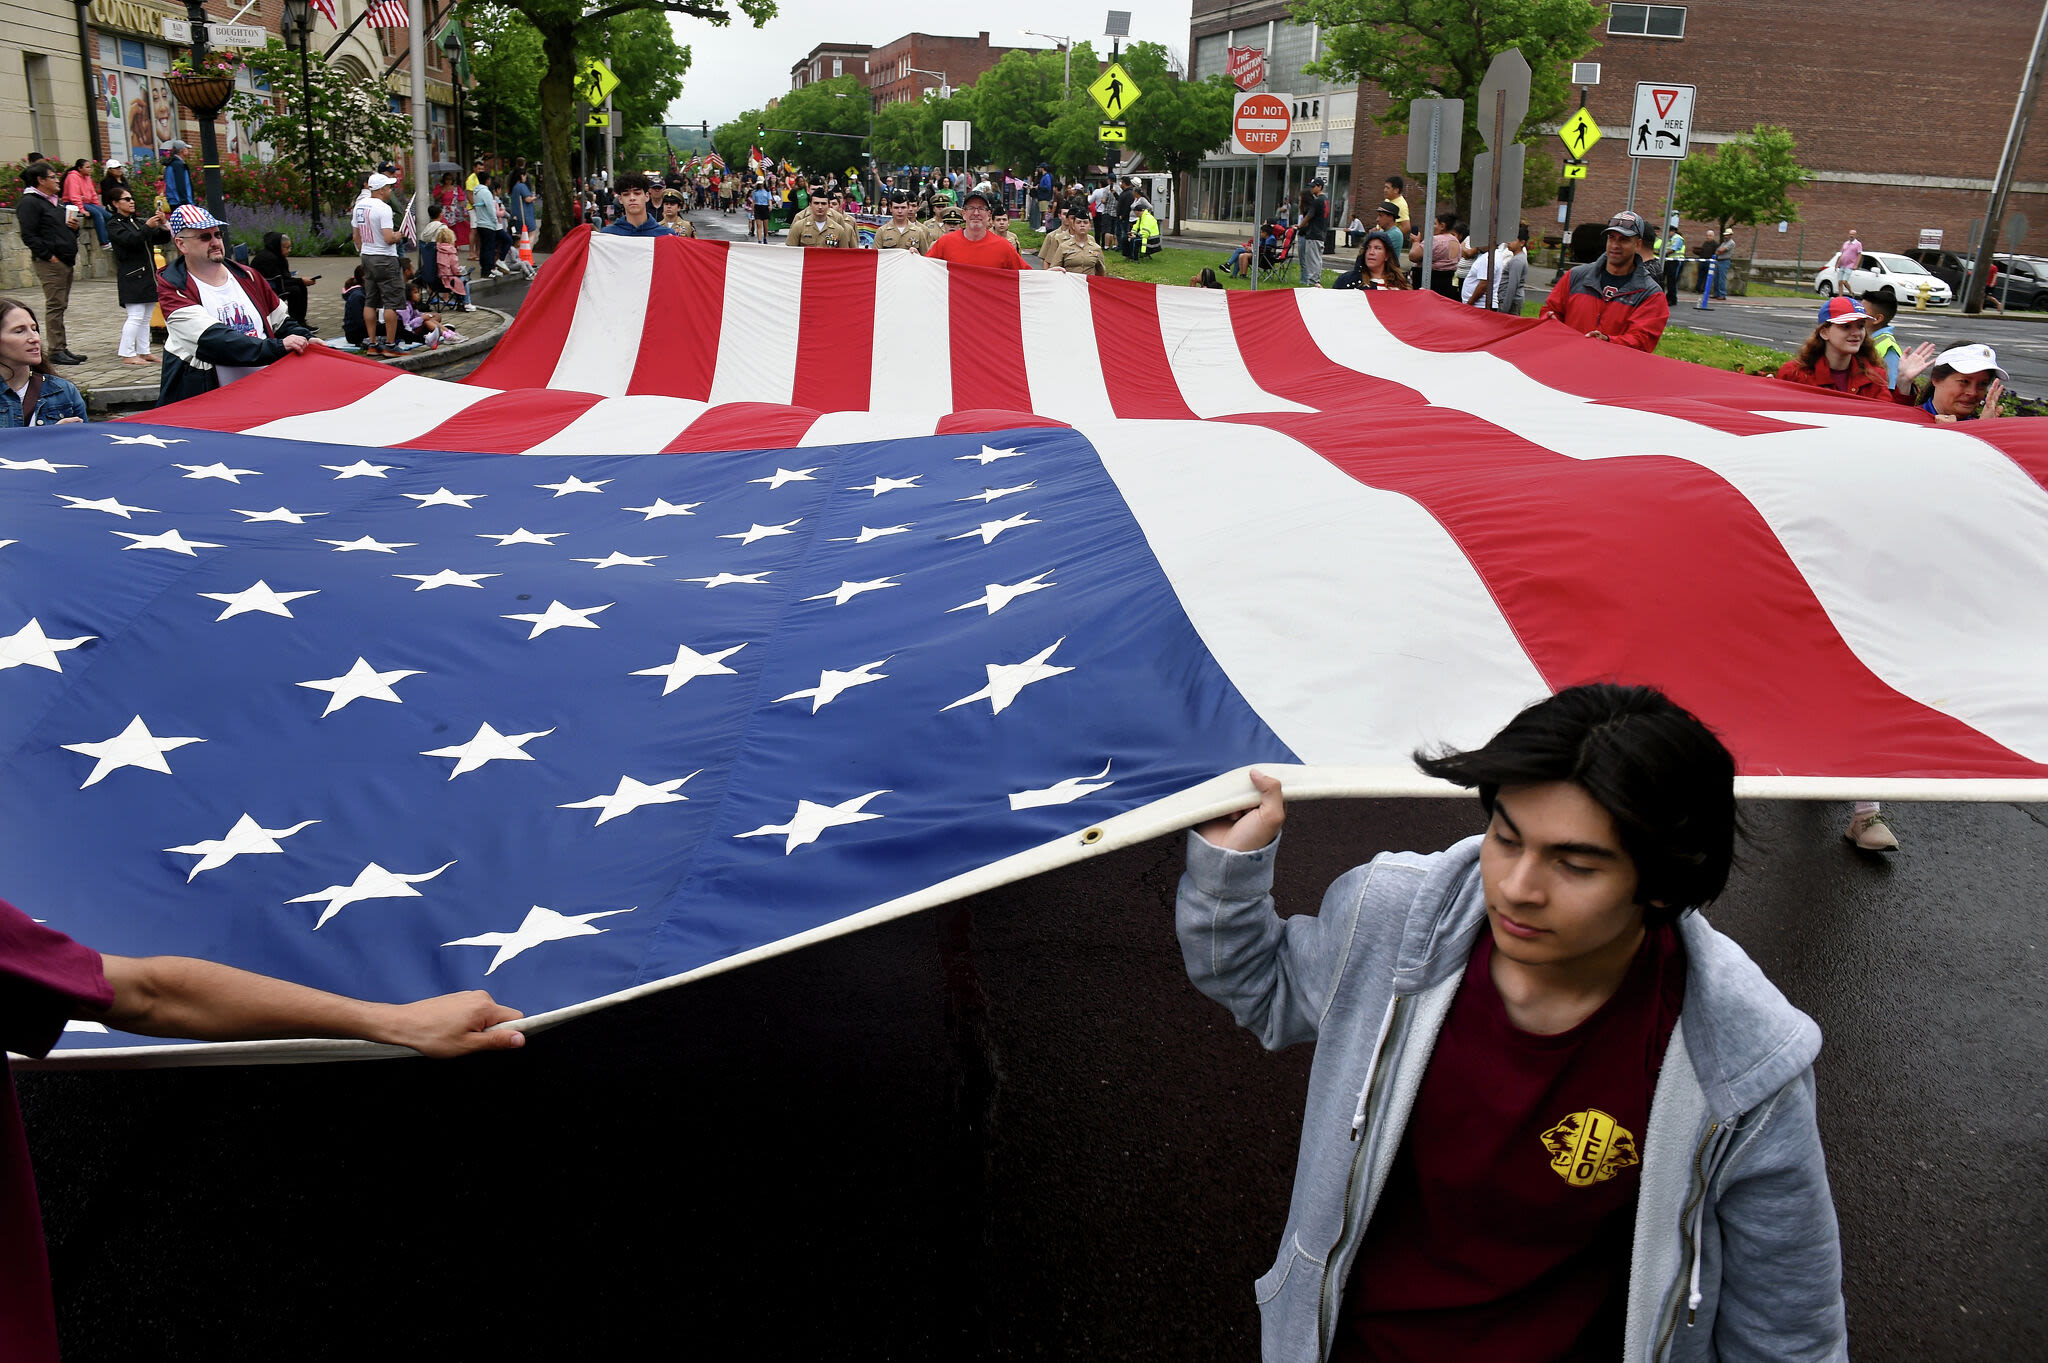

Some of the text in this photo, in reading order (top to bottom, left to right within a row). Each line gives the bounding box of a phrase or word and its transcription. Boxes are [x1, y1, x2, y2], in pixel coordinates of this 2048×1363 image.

[215, 27, 259, 37] BOUGHTON
[1237, 52, 1250, 65] THE
[1232, 55, 1262, 77] SALVATION
[1242, 67, 1260, 85] ARMY
[1243, 105, 1283, 116] DO NOT
[1664, 119, 1684, 130] HERE
[1245, 132, 1278, 142] ENTER
[1655, 139, 1663, 149] TO
[1576, 1118, 1602, 1179] LEO
